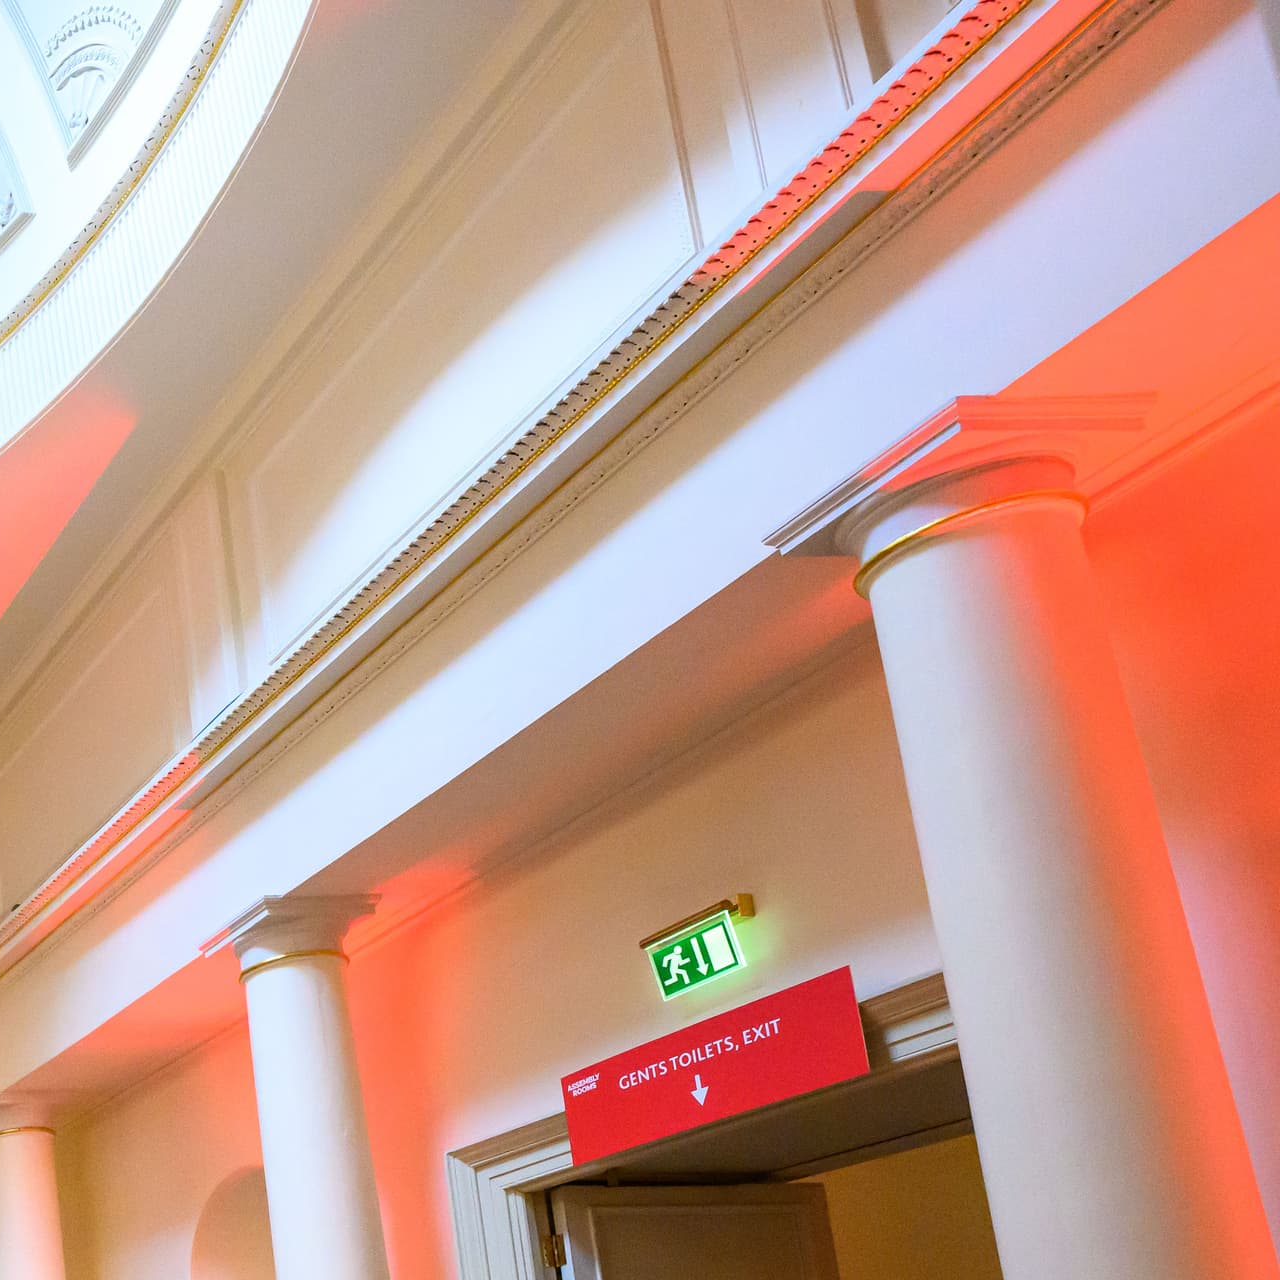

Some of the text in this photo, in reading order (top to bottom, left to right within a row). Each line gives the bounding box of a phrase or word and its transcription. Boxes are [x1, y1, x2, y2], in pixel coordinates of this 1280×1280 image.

[618, 1018, 781, 1090] GENTS TOILETS, EXIT
[567, 1072, 600, 1092] ASSEMBLY
[572, 1082, 597, 1097] ROOMS
